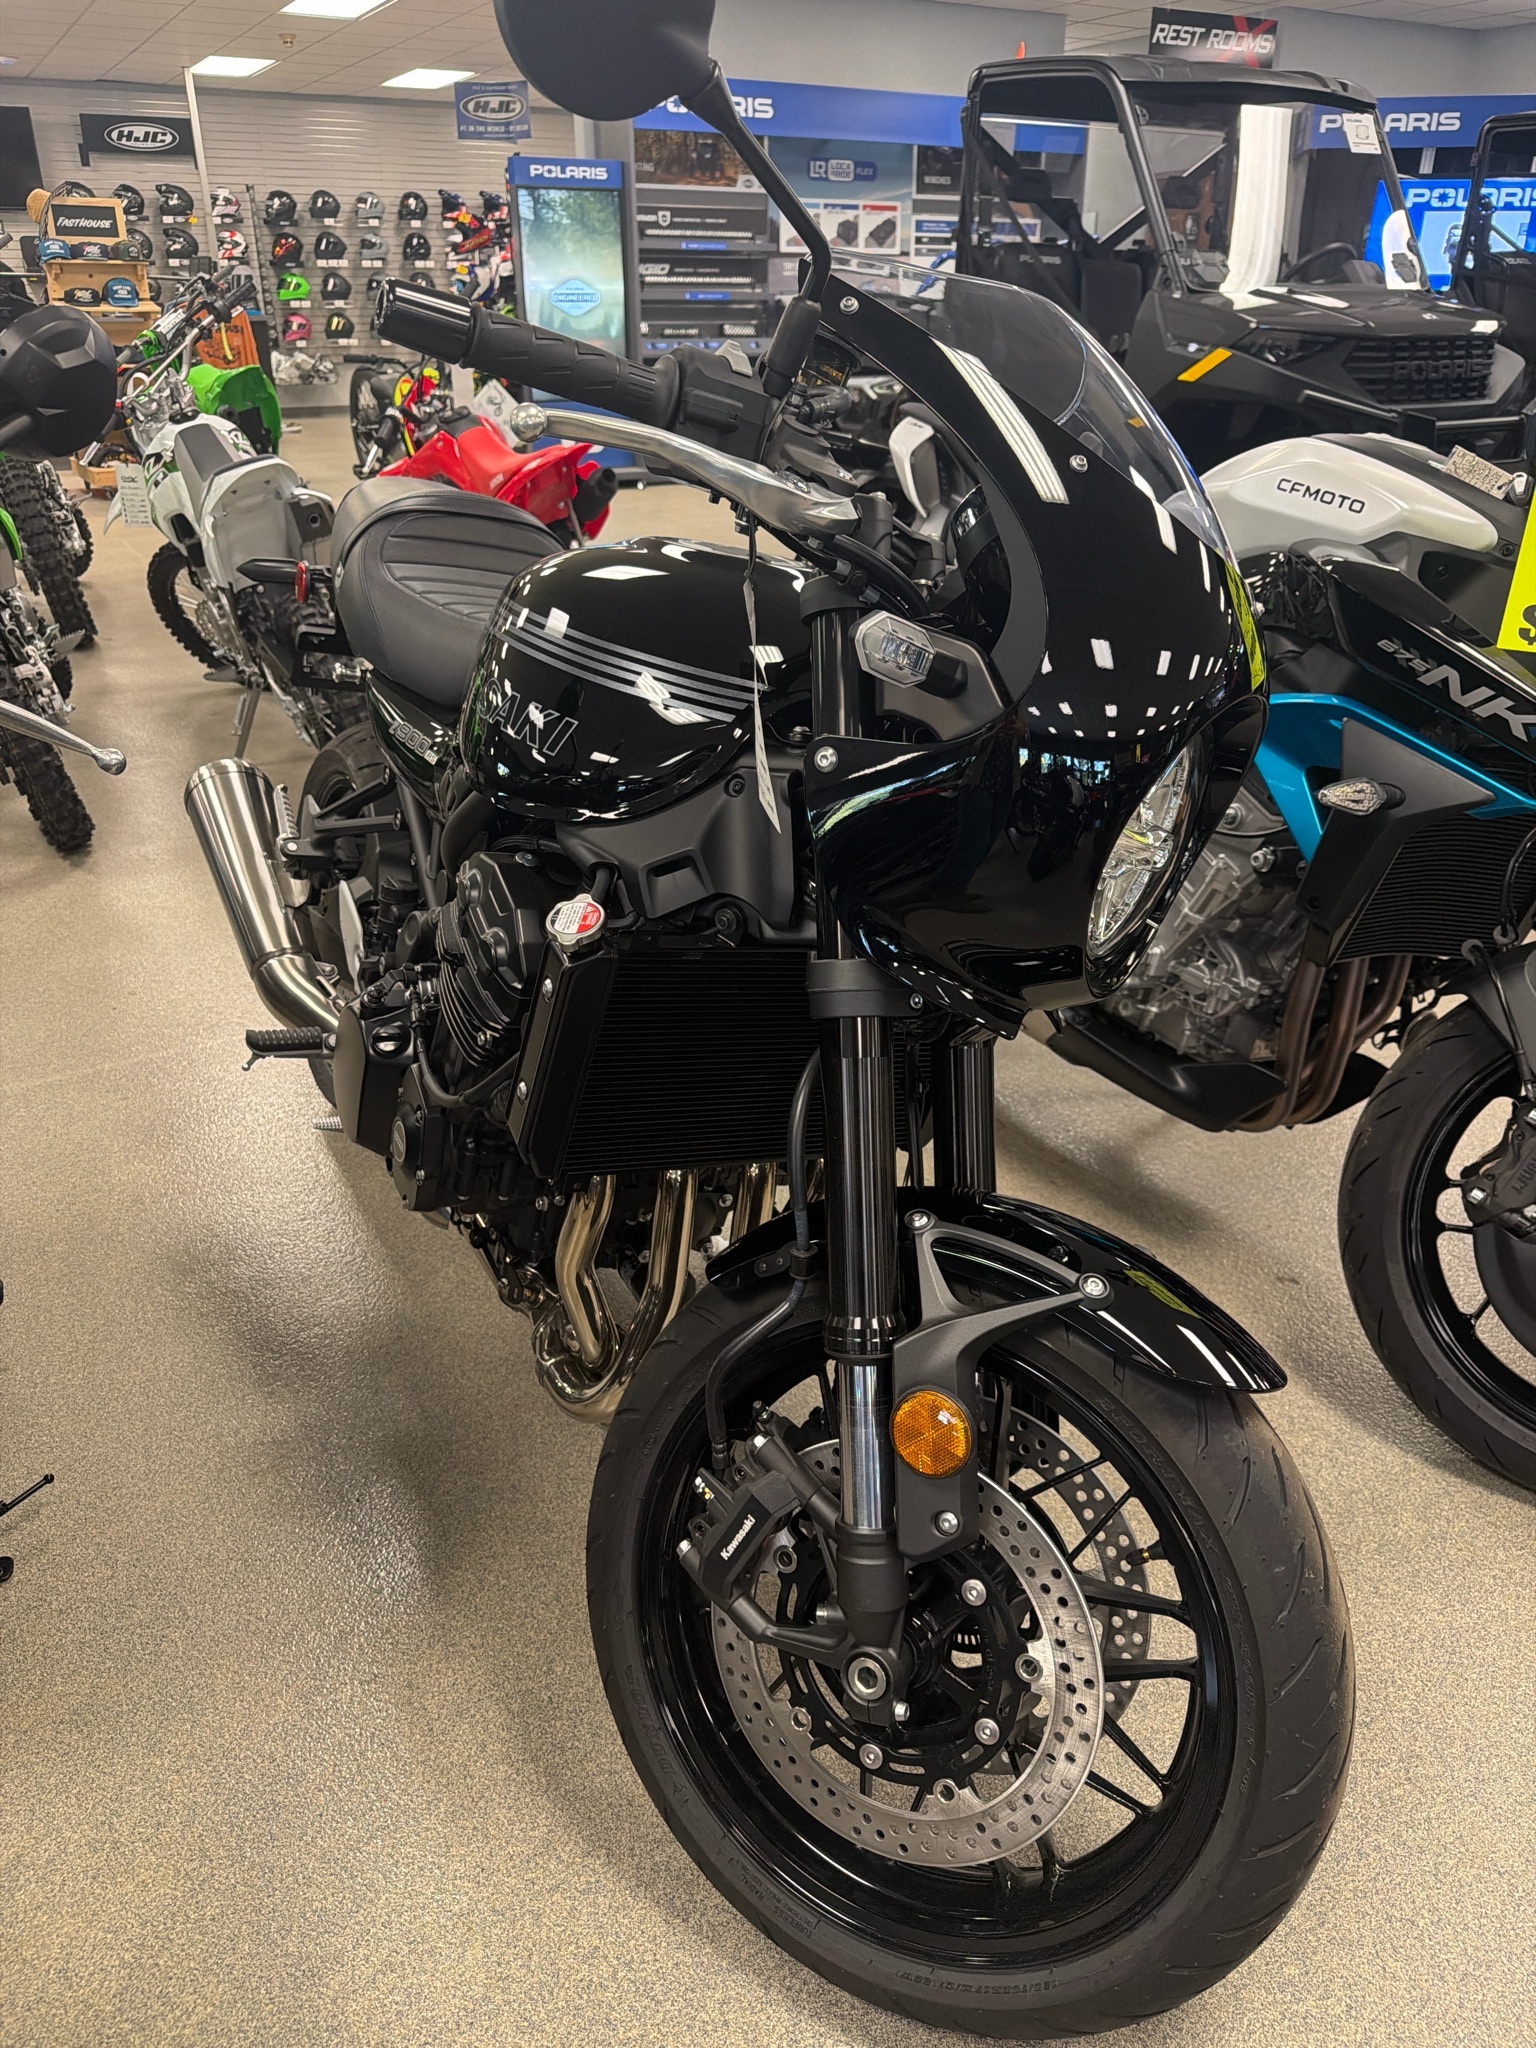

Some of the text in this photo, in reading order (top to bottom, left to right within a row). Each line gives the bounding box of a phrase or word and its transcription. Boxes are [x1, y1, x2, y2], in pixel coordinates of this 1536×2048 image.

[1151, 23, 1274, 54] REST ROOMS
[472, 100, 517, 113] HJC
[1318, 111, 1461, 133] PARIS
[116, 129, 169, 144] HJC
[530, 164, 608, 180] POLARIS
[809, 161, 827, 178] LR
[56, 216, 113, 229] FASTHOUSE
[1276, 477, 1366, 514] CFMOTO
[1376, 638, 1536, 743] 675 NK
[719, 1514, 757, 1562] Kawasaki
[772, 1904, 813, 1939] TUBELESS
